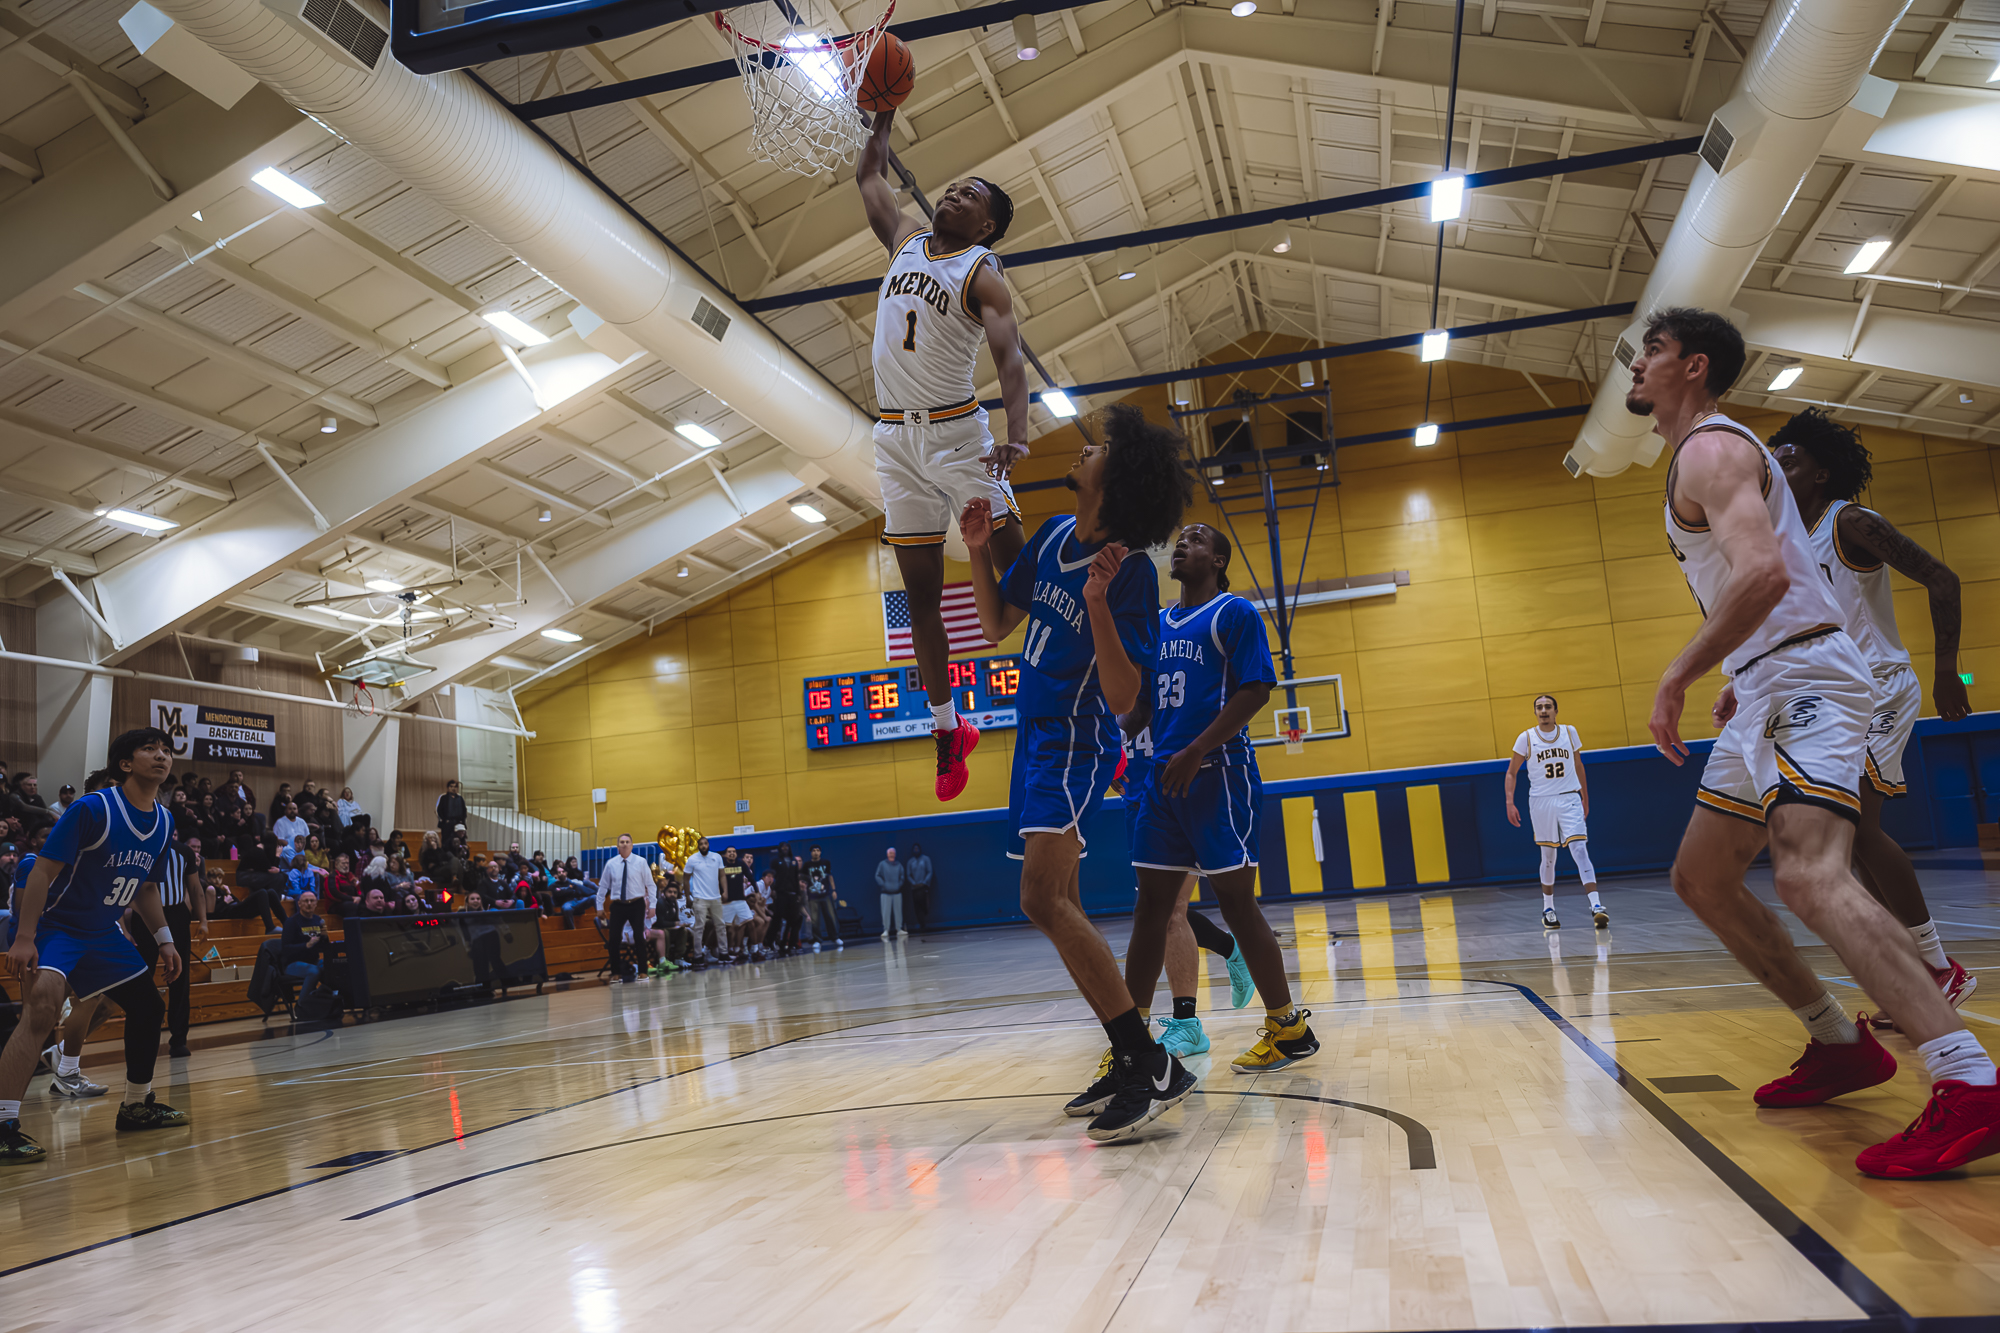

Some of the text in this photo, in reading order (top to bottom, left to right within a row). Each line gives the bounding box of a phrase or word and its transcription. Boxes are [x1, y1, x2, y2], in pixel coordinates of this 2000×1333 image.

[884, 271, 950, 316] MENDO
[903, 309, 917, 353] 1
[1024, 618, 1053, 668] 11
[1159, 639, 1205, 665] AMEDA
[991, 668, 1020, 695] 43
[1157, 670, 1186, 710] 23
[808, 689, 831, 710] 05
[840, 687, 853, 707] 2
[868, 682, 899, 710] 36
[968, 690, 975, 711] 1
[205, 712, 268, 728] MENDOCINO COLLEGE
[875, 725, 901, 736] HOME
[905, 723, 917, 732] OF
[209, 726, 265, 743] BASKETBALL
[816, 725, 829, 745] 4
[845, 722, 858, 742] 4
[225, 746, 263, 759] WE WILL.
[1536, 748, 1569, 763] MENDO
[1544, 762, 1564, 779] 32
[103, 876, 139, 907] 30
